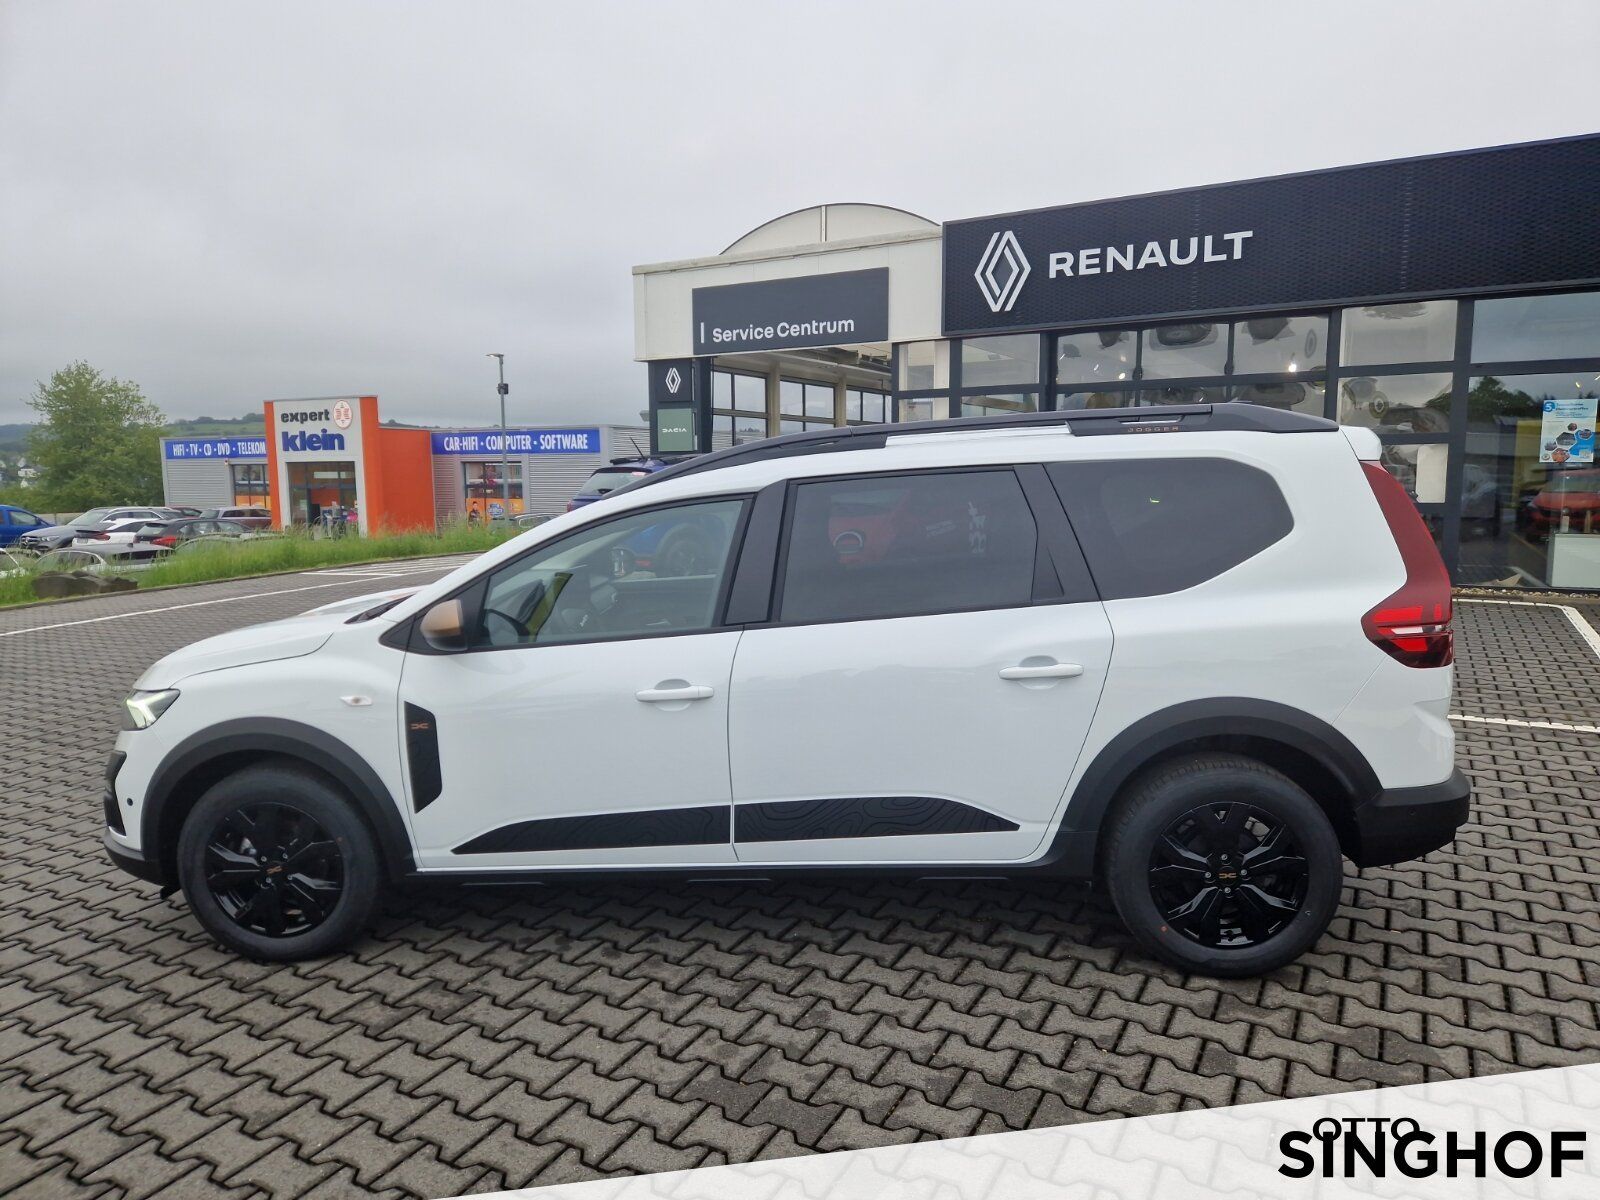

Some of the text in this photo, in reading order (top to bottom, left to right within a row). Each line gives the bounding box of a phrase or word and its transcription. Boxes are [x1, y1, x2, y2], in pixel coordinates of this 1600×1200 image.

[1049, 230, 1254, 279] RENAULT
[712, 319, 855, 343] Service Centrum
[281, 409, 330, 424] expert
[172, 443, 185, 456] HIFI
[189, 443, 199, 456] TV
[203, 443, 212, 455] CD
[217, 442, 231, 455] DVD
[281, 428, 345, 452] klein
[443, 436, 479, 451] CAR-HIFI
[540, 433, 588, 450] SOFTWARE
